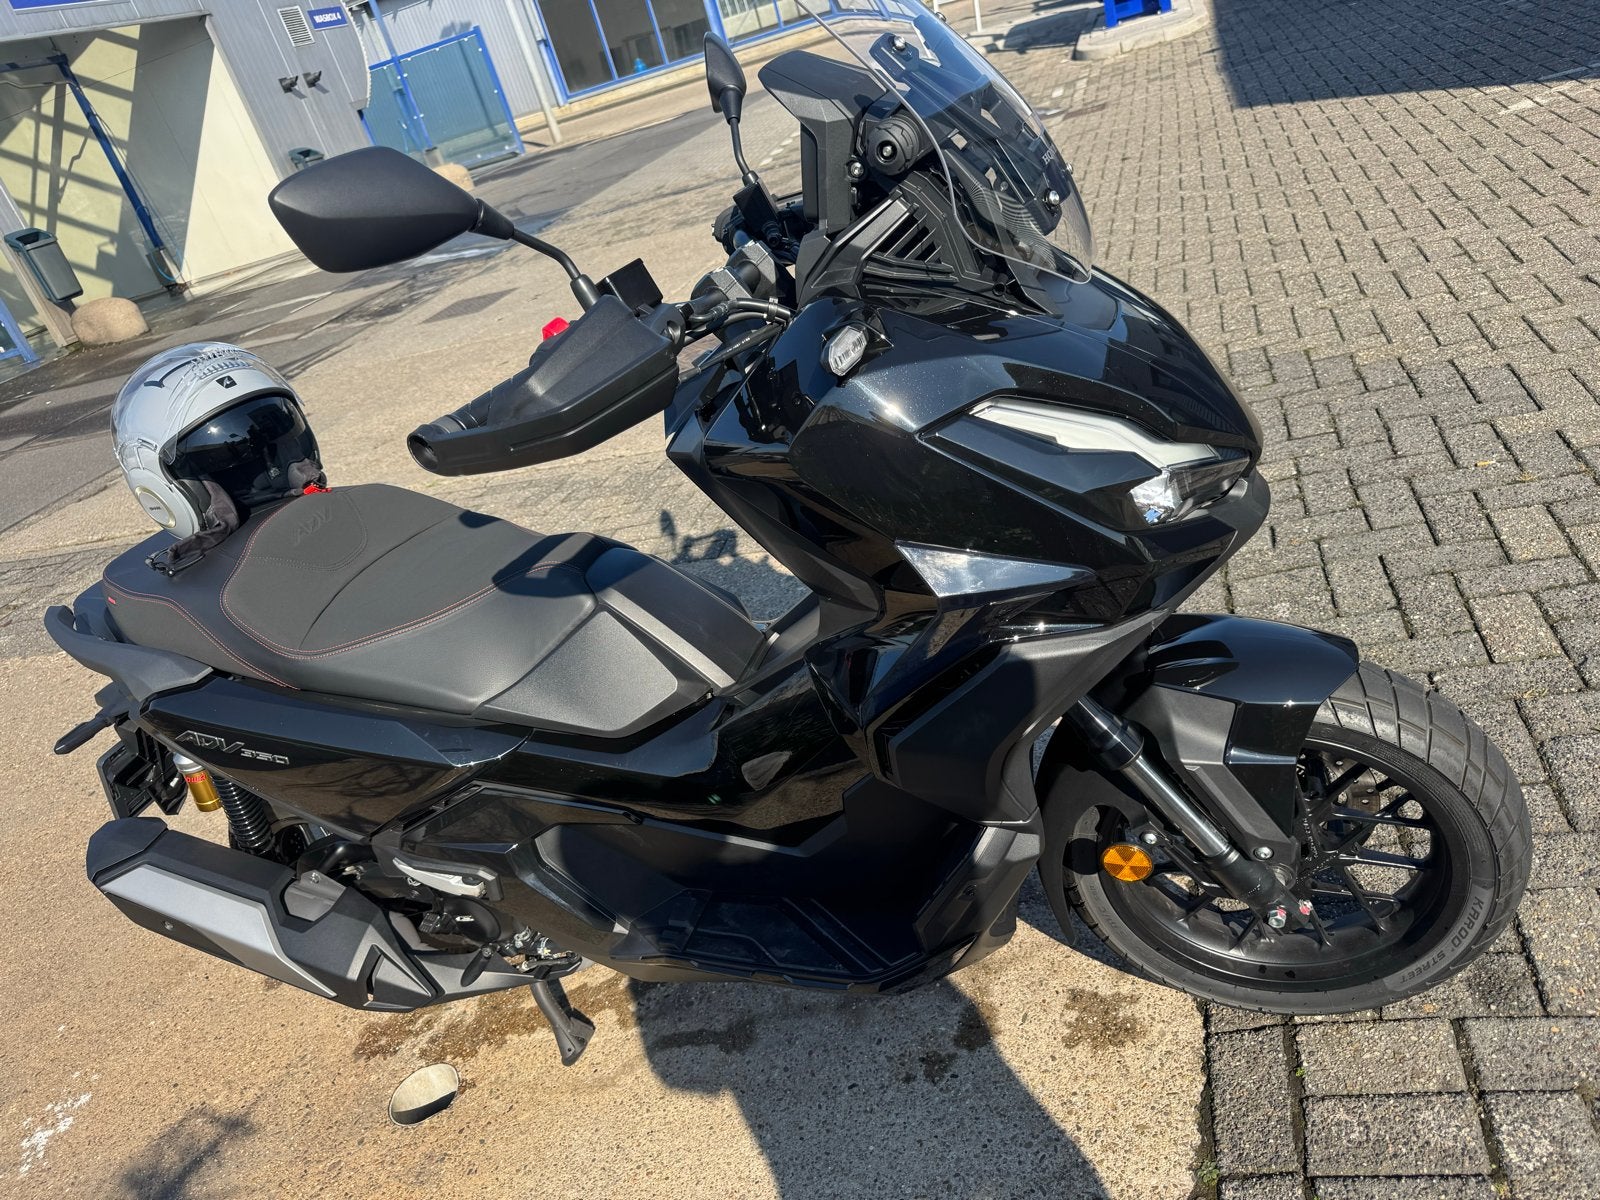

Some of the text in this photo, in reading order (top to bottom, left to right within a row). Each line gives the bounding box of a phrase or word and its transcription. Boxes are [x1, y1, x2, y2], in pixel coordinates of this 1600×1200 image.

[313, 11, 342, 23] WASBOX 4
[1401, 950, 1446, 983] STREET
